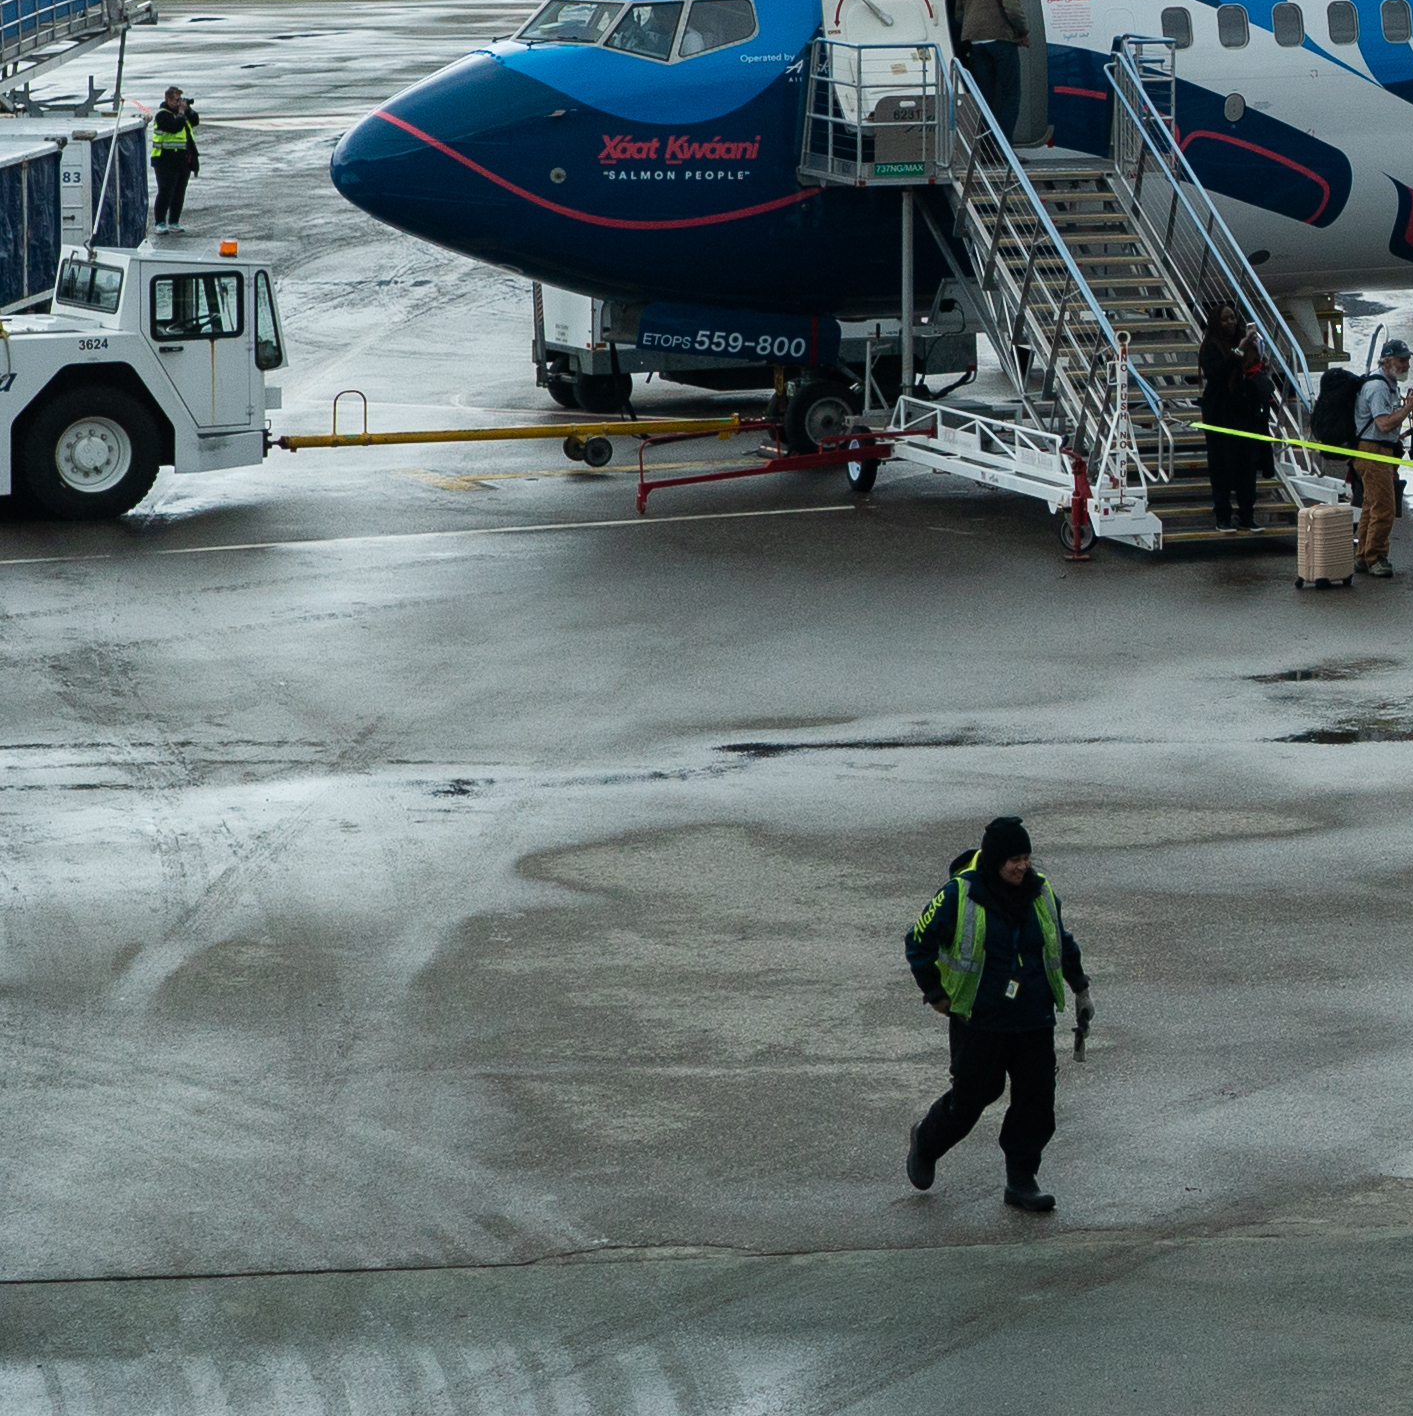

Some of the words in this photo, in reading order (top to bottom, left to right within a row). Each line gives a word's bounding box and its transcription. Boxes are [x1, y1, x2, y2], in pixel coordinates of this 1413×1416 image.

[740, 53, 782, 64] Operated
[784, 52, 796, 62] by
[603, 170, 676, 180] "SALMON
[686, 170, 751, 180] PEOPLE"
[876, 164, 924, 174] 737NG/MAX
[78, 338, 109, 351] 3624
[642, 332, 691, 350] ETOPS
[694, 330, 806, 358] 559-800
[1120, 354, 1128, 372] NO
[1120, 383, 1128, 420] PUSH
[1119, 431, 1127, 449] NO
[913, 890, 945, 943] Alaska
